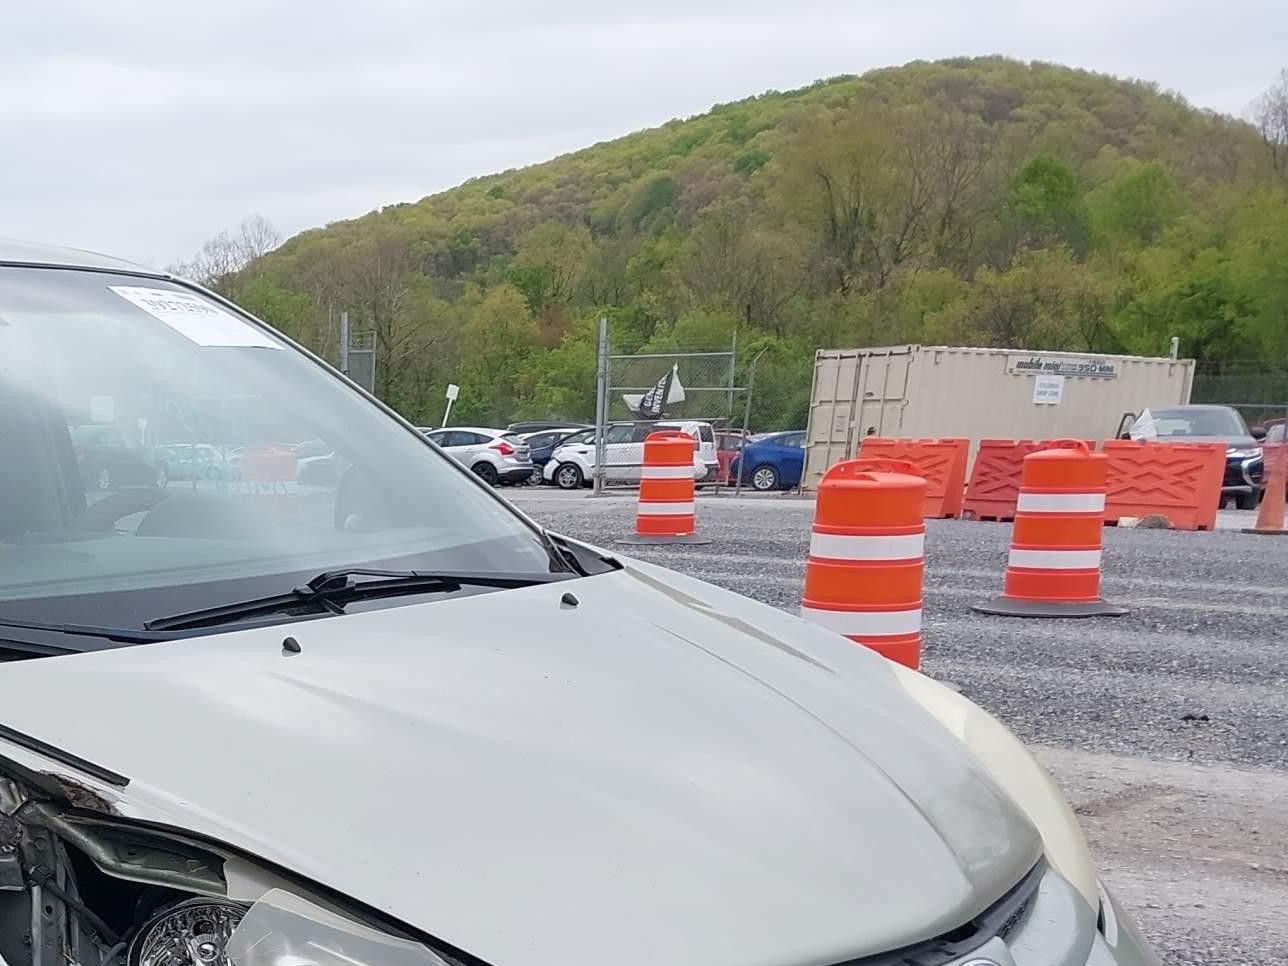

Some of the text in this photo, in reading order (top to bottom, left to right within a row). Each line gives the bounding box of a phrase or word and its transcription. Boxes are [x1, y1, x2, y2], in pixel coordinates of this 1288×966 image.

[1016, 358, 1043, 370] mobile
[1043, 361, 1062, 371] mini
[1078, 364, 1097, 373] 950
[651, 374, 668, 413] INVENTO
